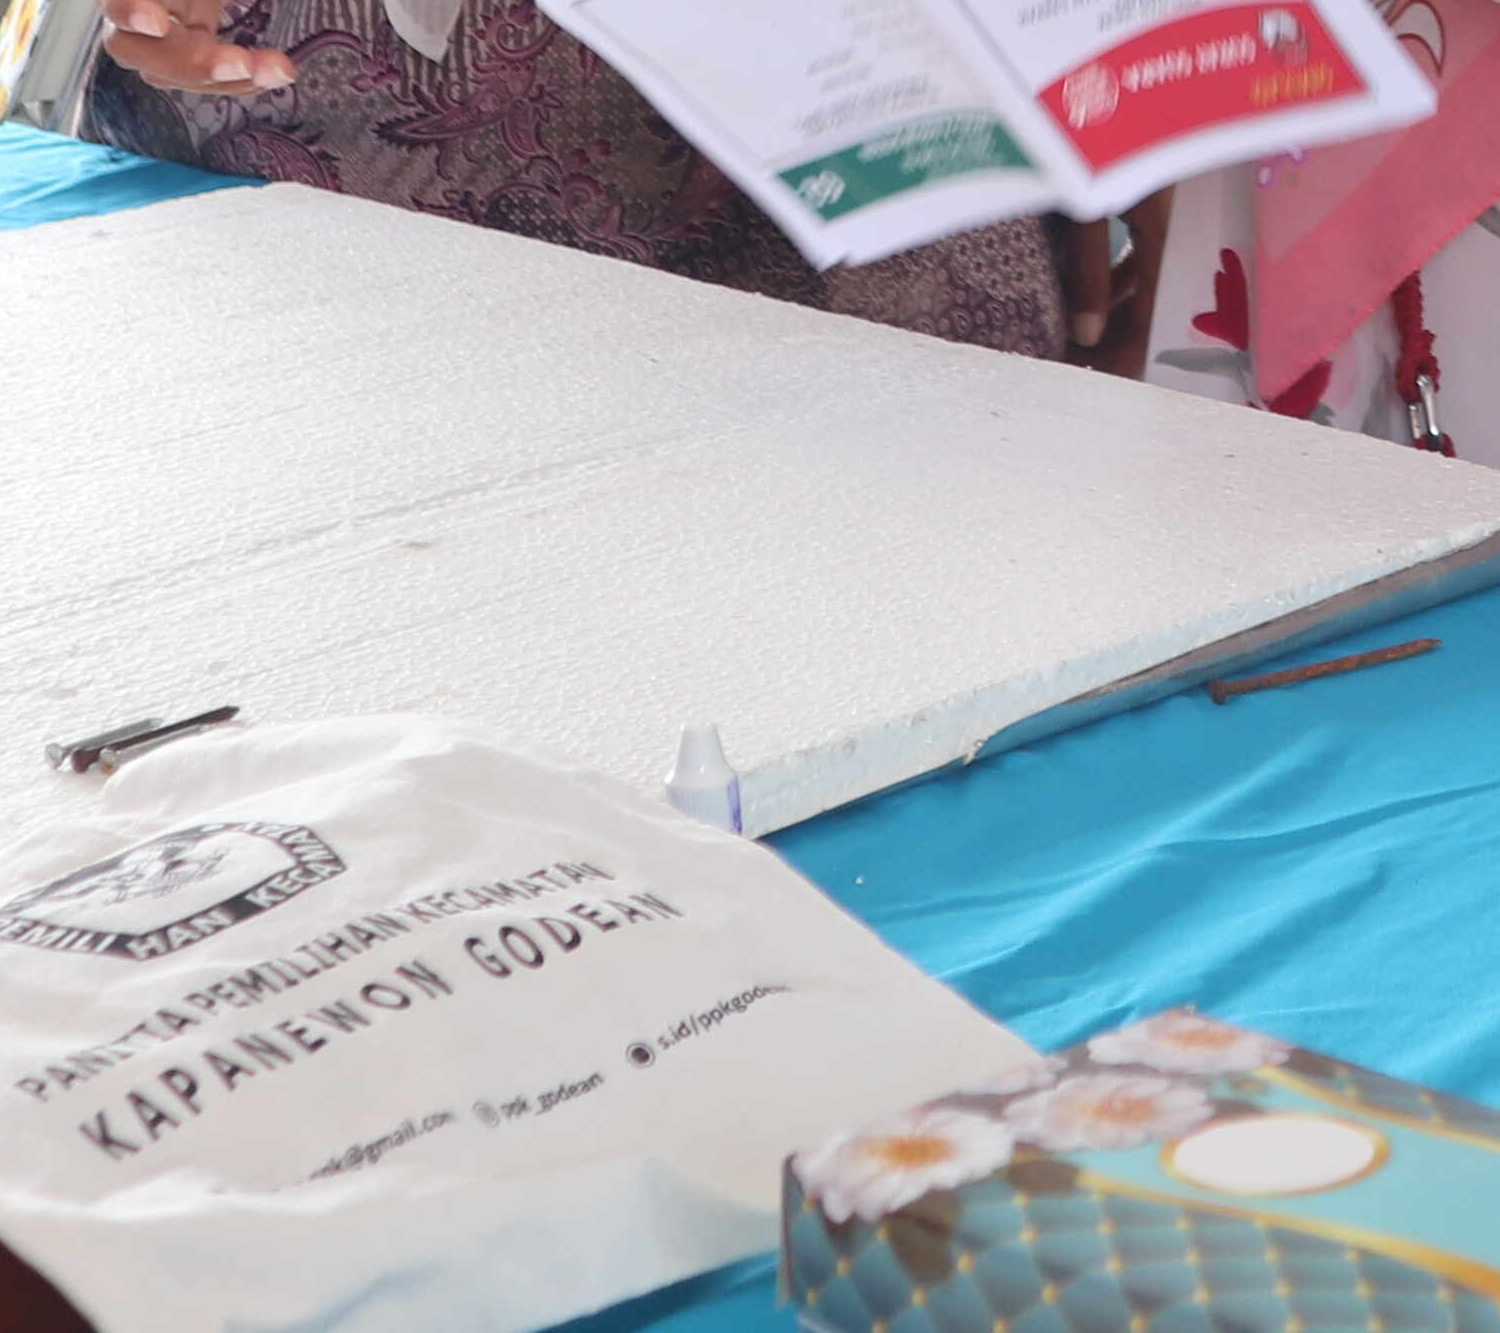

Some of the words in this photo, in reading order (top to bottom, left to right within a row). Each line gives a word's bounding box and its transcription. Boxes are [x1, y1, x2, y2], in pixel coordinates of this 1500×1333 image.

[79, 960, 454, 1161] KAPANEWON
[463, 893, 684, 979] GODEAN
[182, 913, 412, 1016] PEMILIHAN
[400, 863, 615, 924] KECAMATAN
